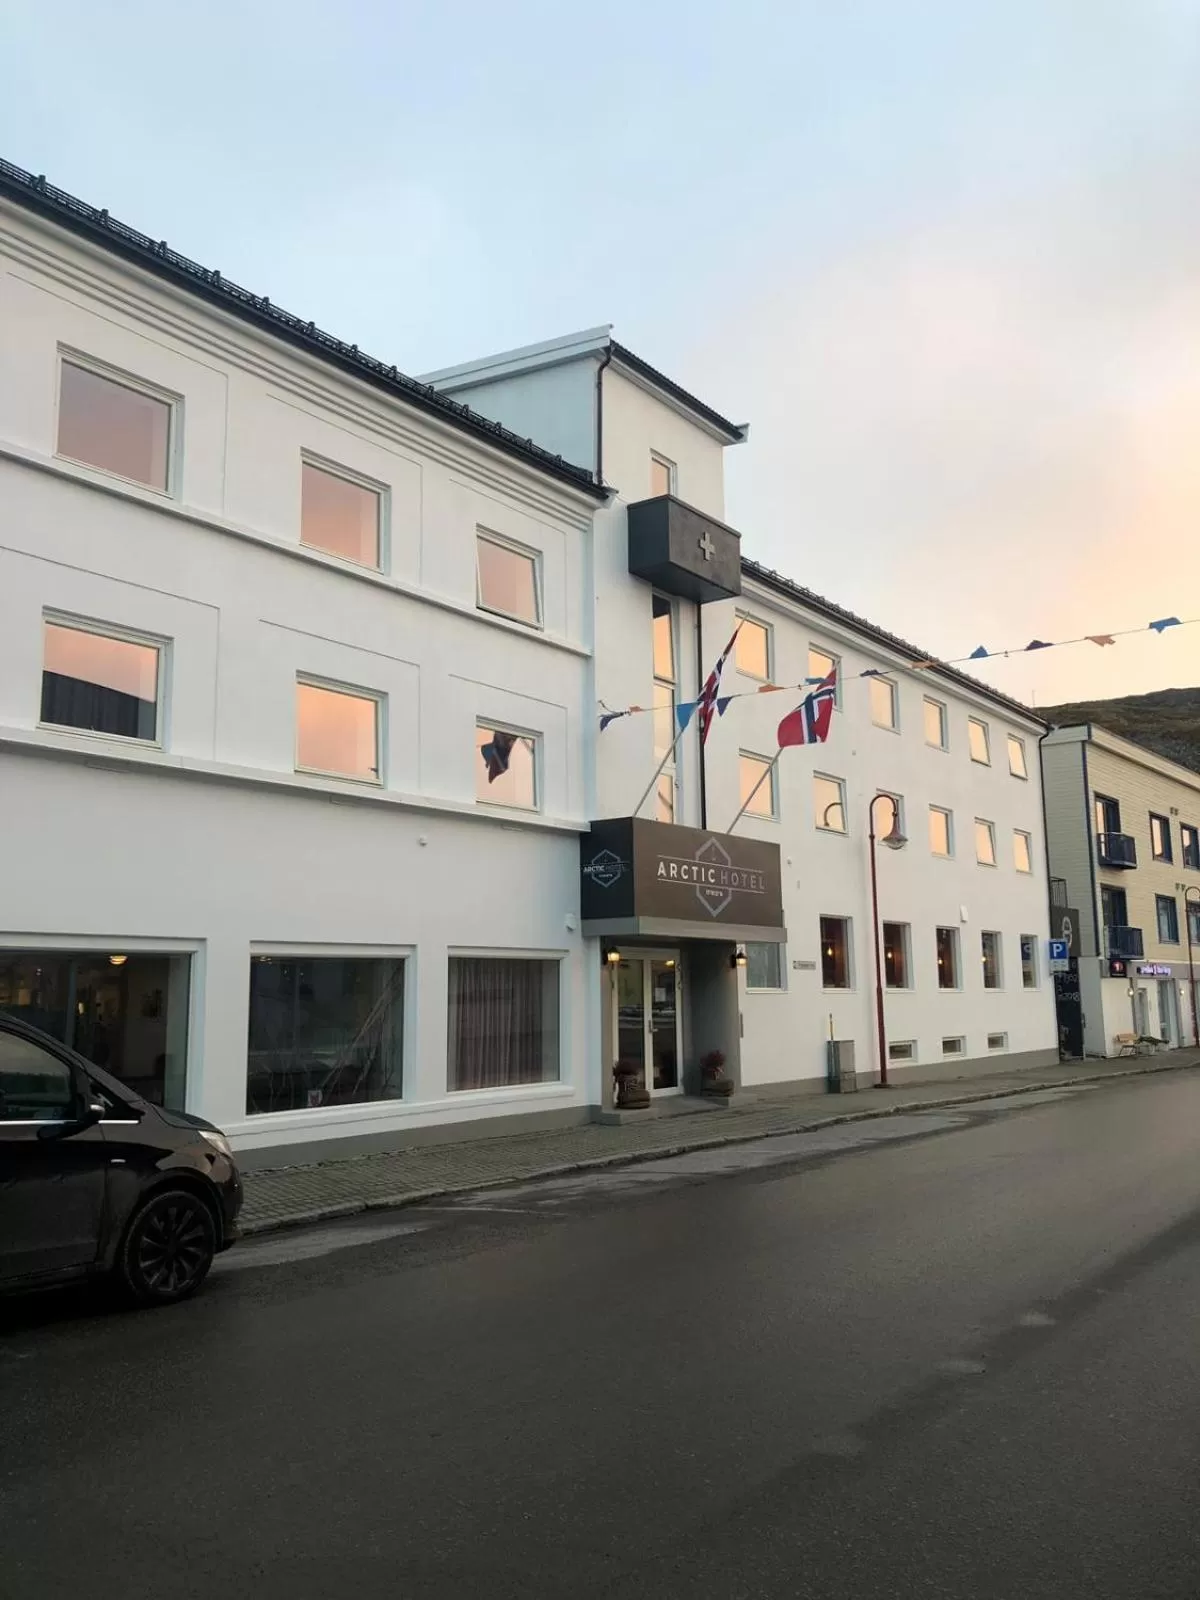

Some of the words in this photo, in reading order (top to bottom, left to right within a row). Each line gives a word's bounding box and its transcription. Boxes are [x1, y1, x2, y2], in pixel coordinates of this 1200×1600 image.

[657, 861, 716, 883] ARCTIC
[720, 870, 765, 890] HOTEL
[1052, 943, 1063, 957] P
